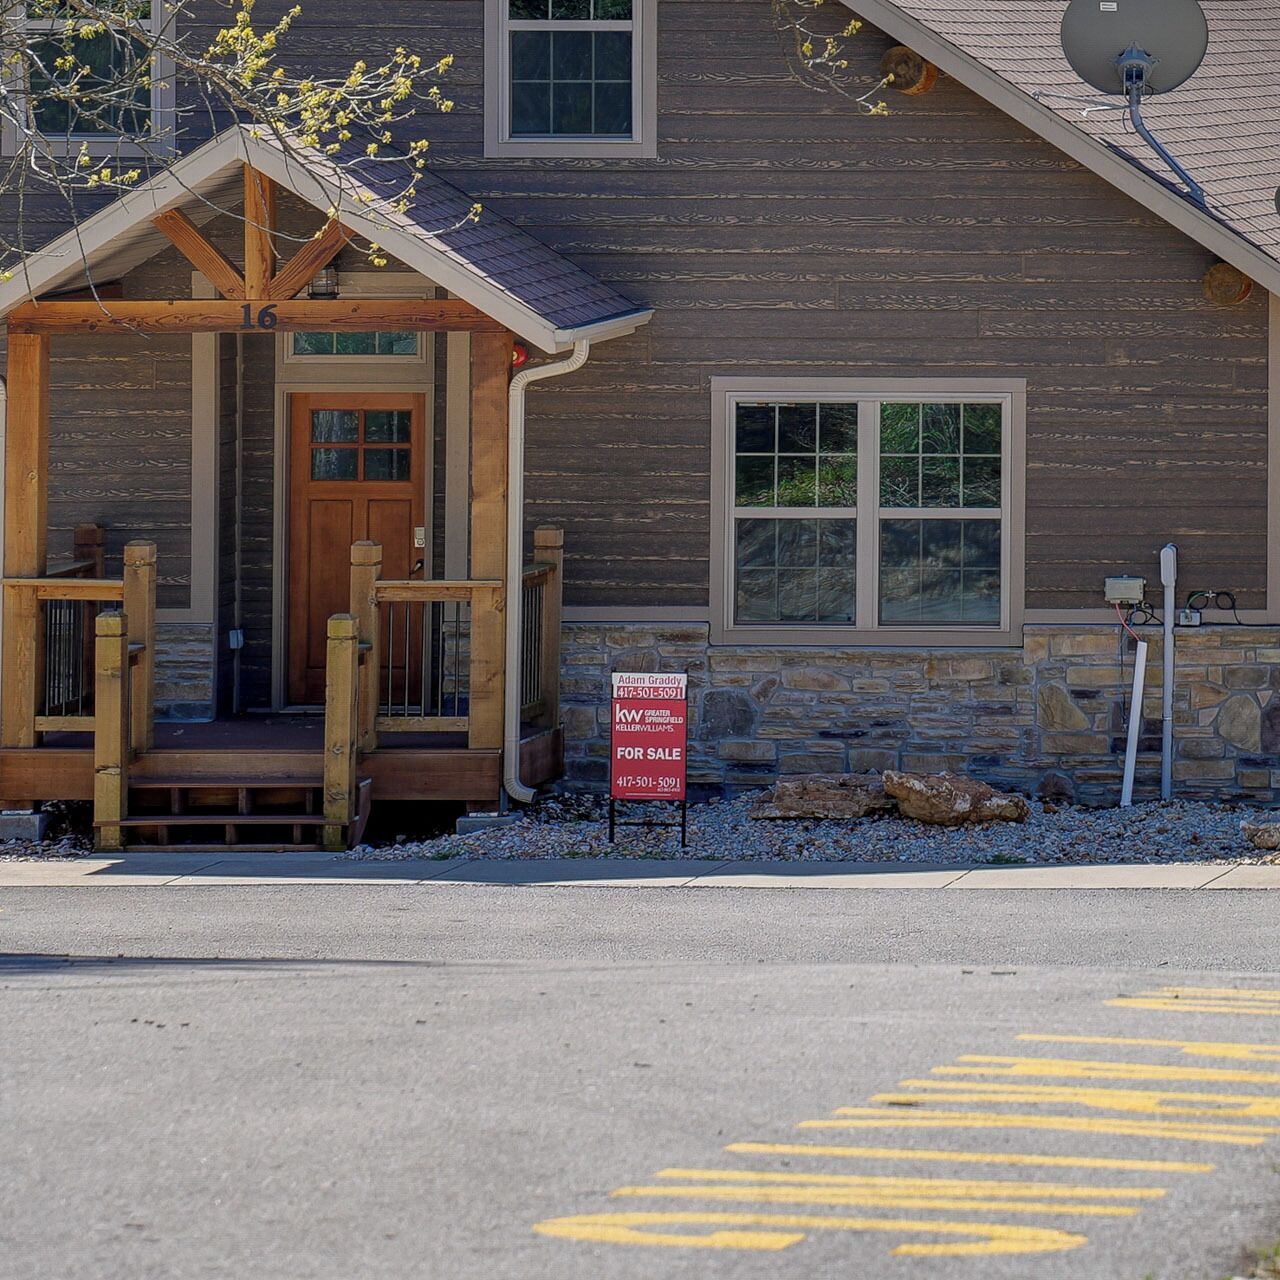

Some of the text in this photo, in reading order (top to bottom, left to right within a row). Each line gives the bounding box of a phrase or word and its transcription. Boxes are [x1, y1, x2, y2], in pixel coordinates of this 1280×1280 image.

[240, 303, 278, 329] 16
[618, 675, 681, 686] Adam Graddy
[618, 687, 682, 698] 417-501-5091
[615, 703, 644, 723] kw
[644, 709, 671, 717] GREATER
[645, 716, 684, 724] SPRINGFIELD
[617, 747, 681, 760] FOR SALE
[617, 776, 680, 788] 417-501-5091
